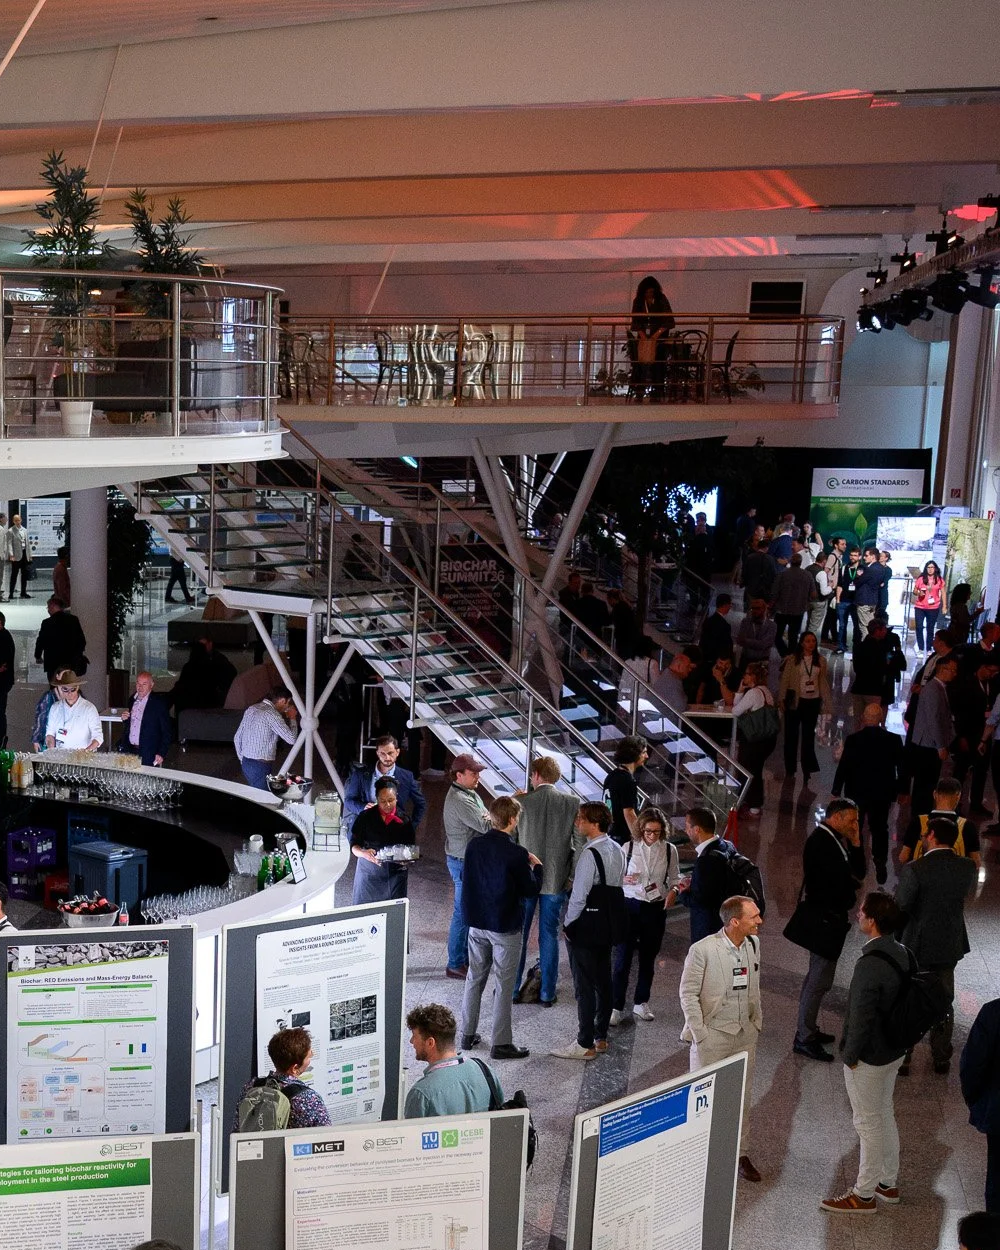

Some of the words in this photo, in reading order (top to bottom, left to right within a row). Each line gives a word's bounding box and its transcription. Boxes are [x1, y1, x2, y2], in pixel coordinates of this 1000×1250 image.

[440, 560, 496, 572] BIOCHAR
[282, 938, 304, 946] ADVANCING
[289, 945, 307, 953] INSIGHTS
[296, 1145, 310, 1154] K1
[314, 1143, 343, 1152] MET
[377, 1137, 405, 1146] BEST
[423, 1133, 438, 1144] TU
[461, 1128, 484, 1136] ICEBE
[115, 1142, 145, 1151] BEST
[35, 1166, 64, 1176] tailoring
[65, 1164, 92, 1172] biochar
[93, 1162, 125, 1172] reactivity
[71, 1172, 109, 1182] production
